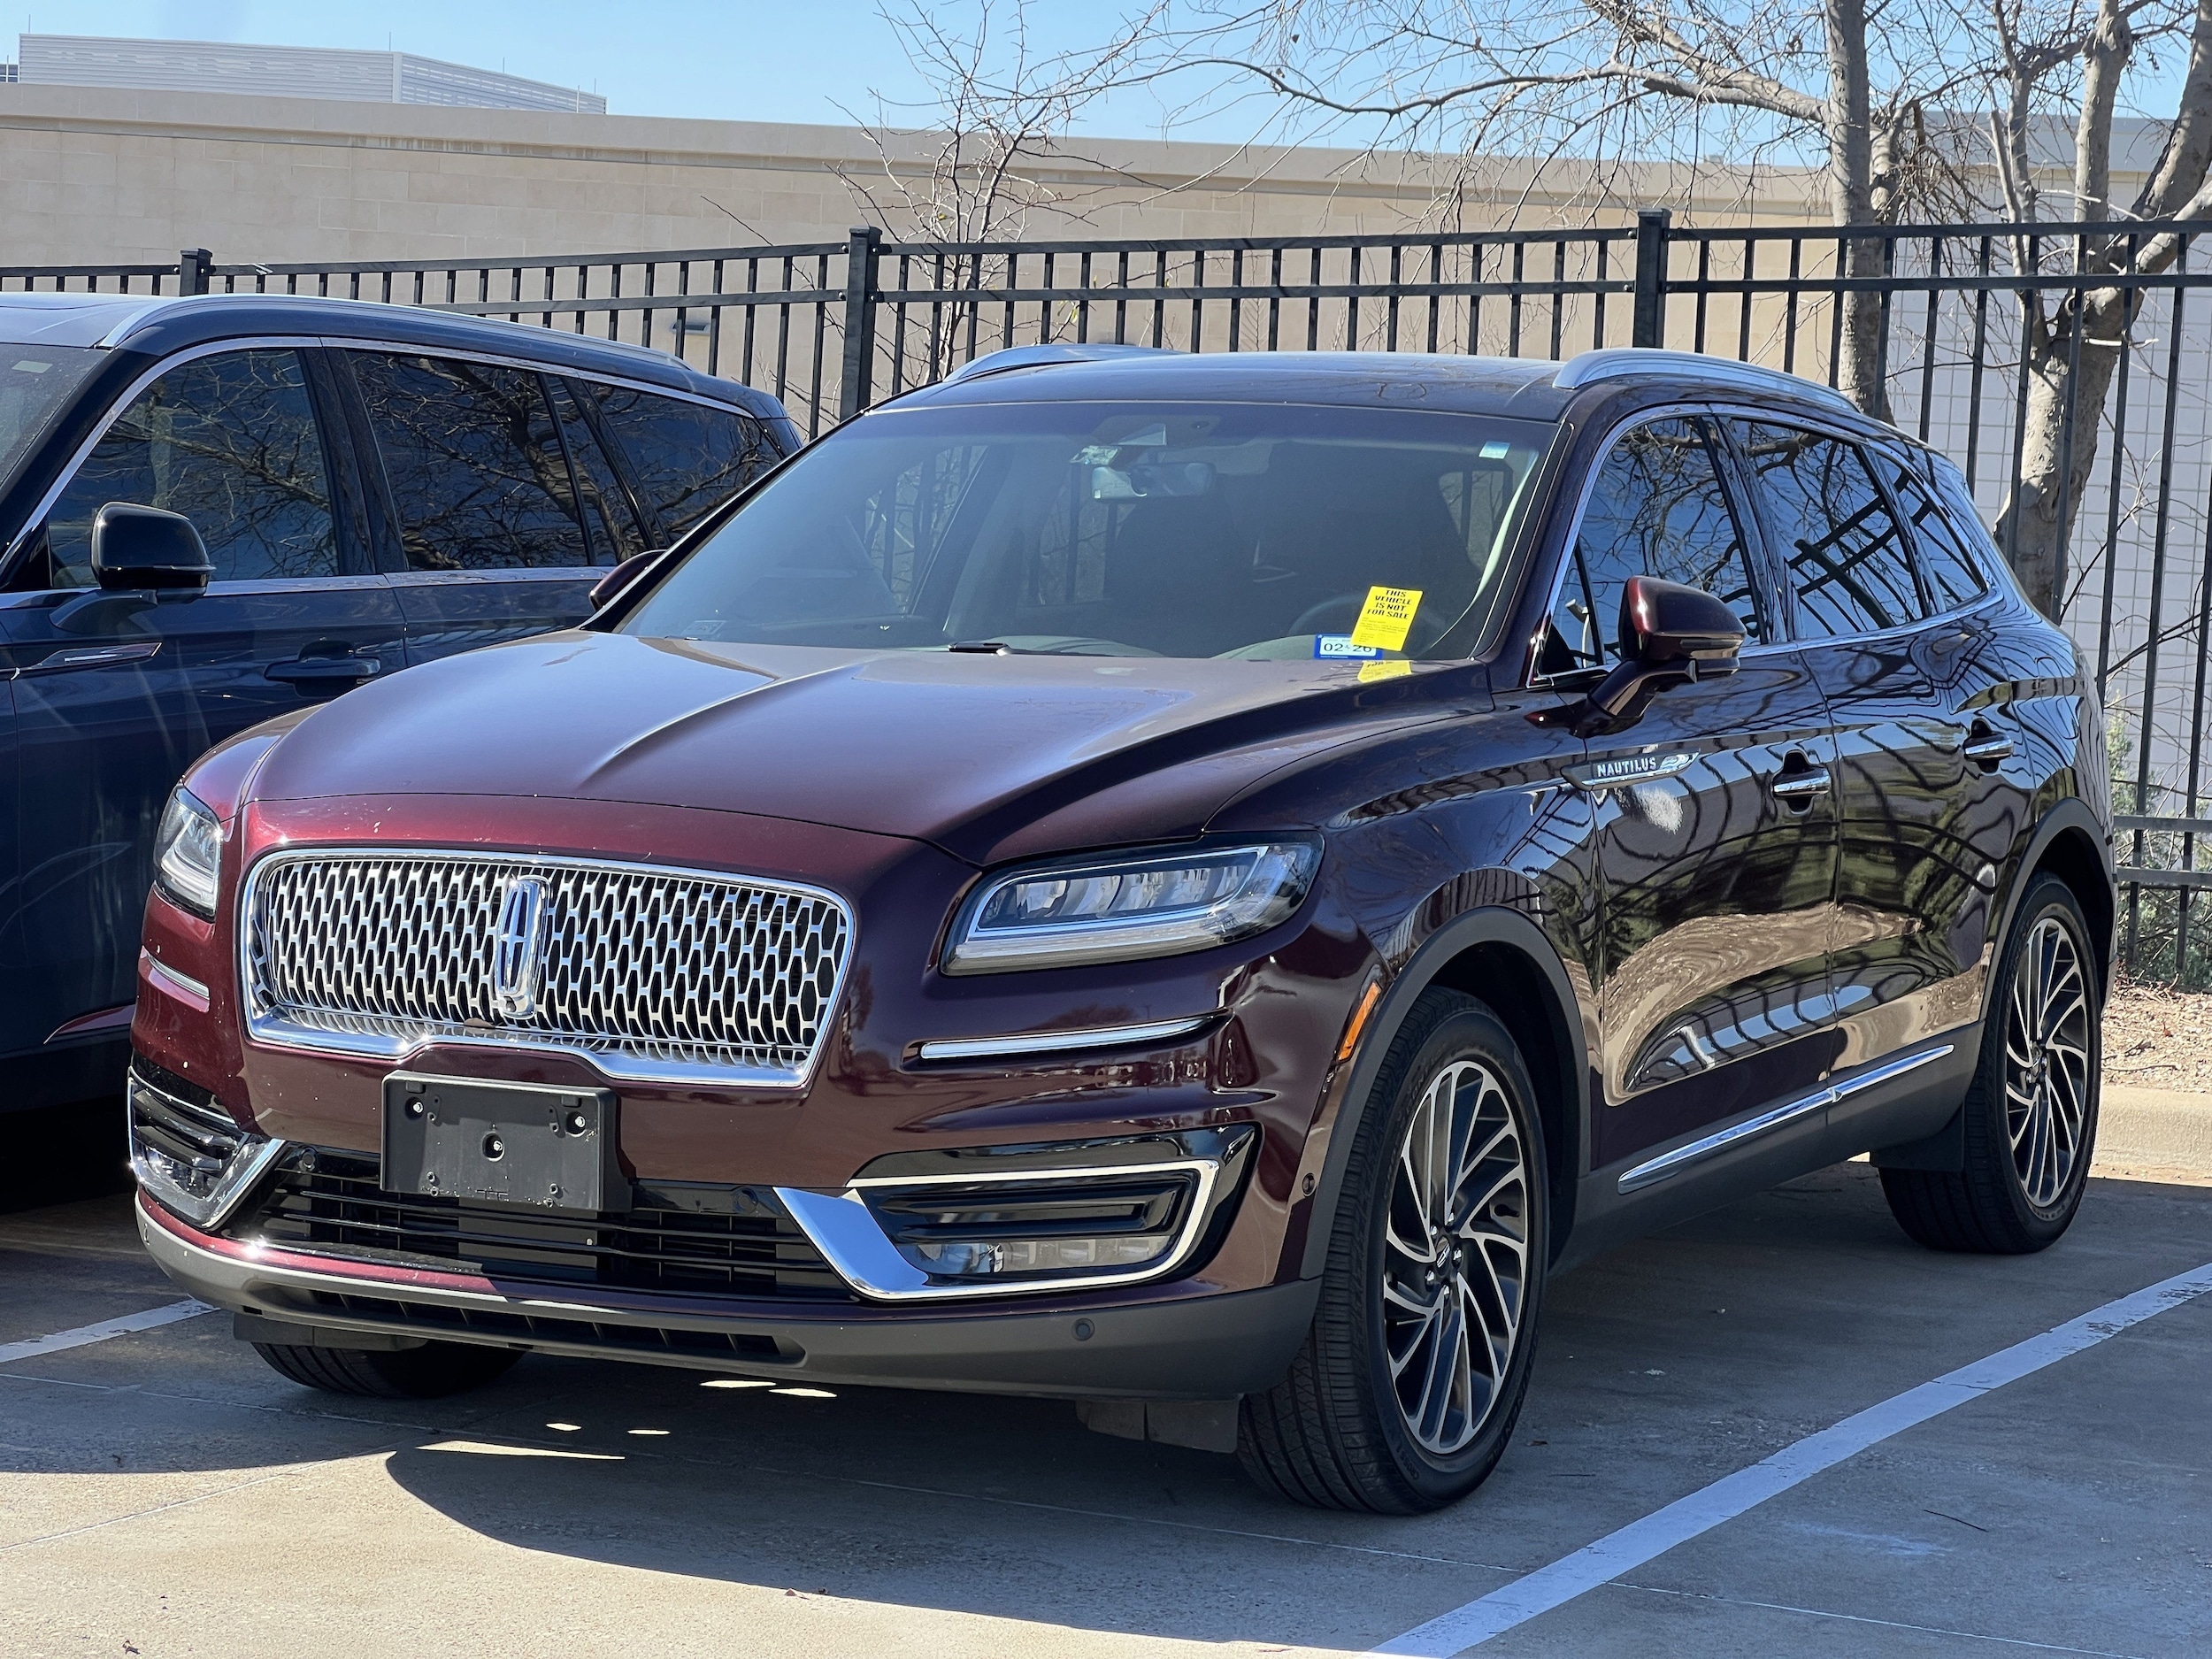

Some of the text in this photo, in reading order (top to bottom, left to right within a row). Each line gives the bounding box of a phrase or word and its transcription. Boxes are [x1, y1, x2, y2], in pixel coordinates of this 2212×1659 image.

[1375, 595, 1412, 605] VEHICLE
[1386, 611, 1409, 619] SALE
[1324, 643, 1343, 652] 02
[1597, 757, 1657, 778] NAUTILUS
